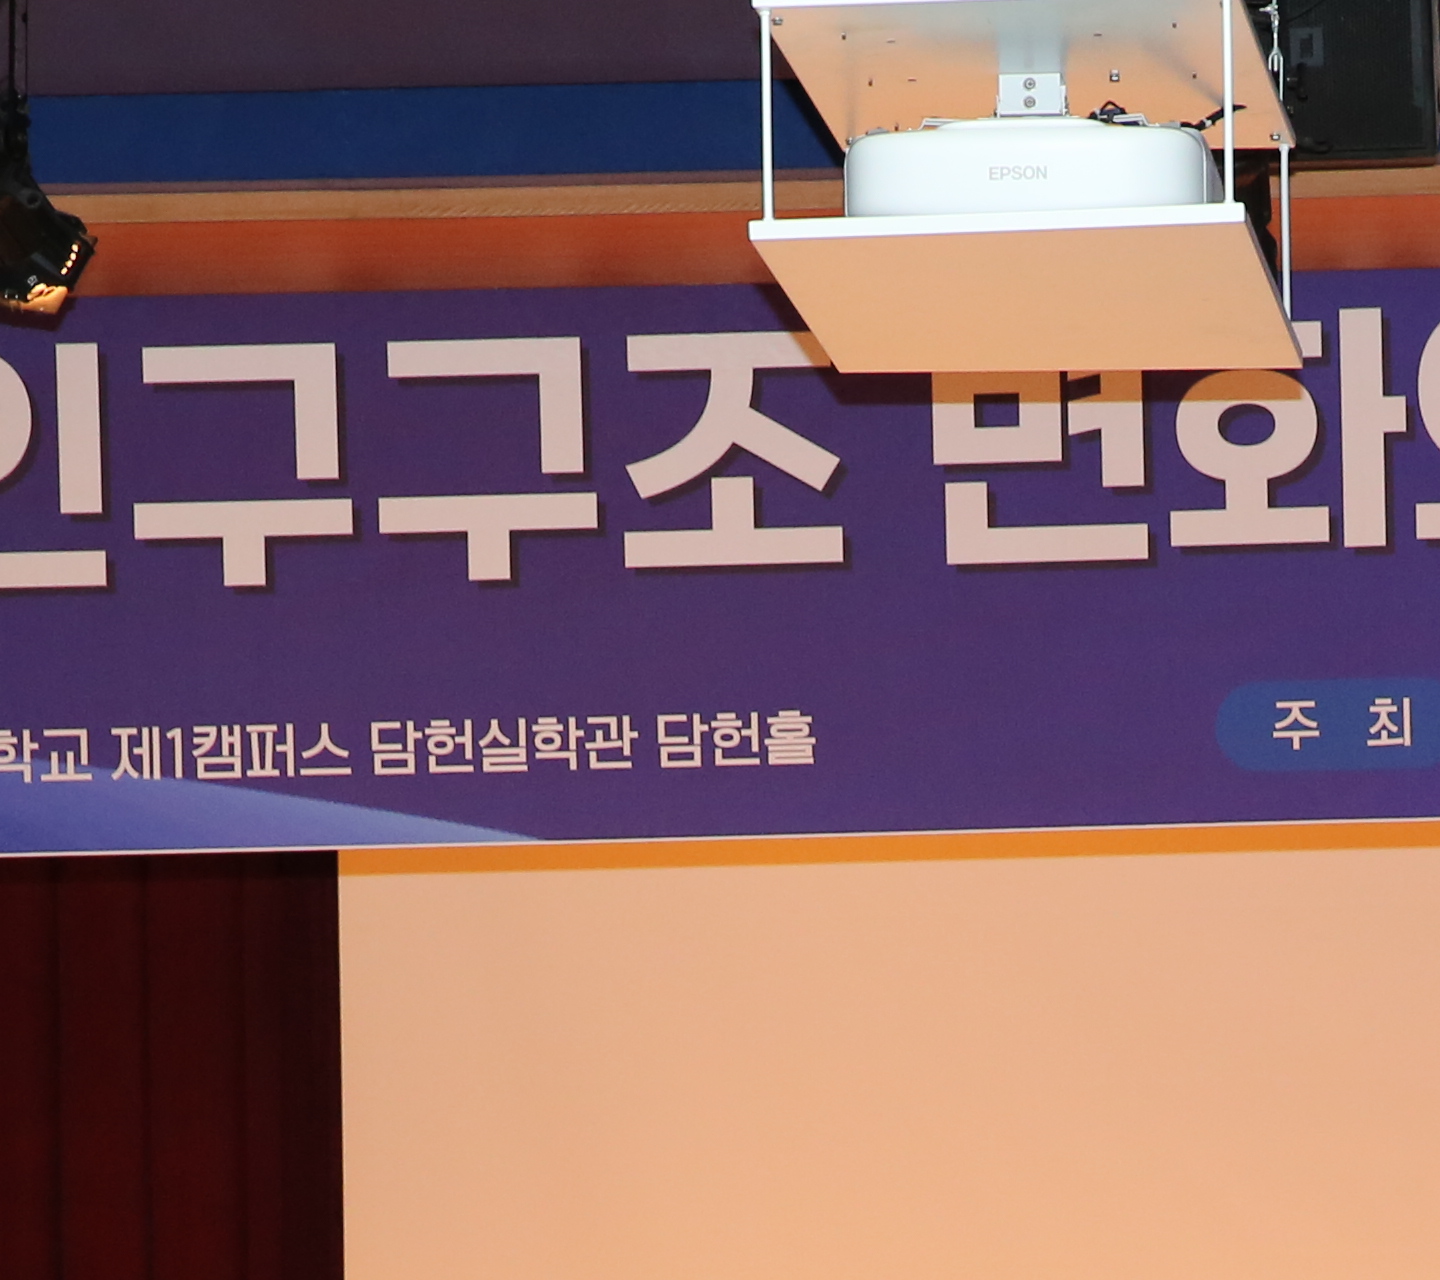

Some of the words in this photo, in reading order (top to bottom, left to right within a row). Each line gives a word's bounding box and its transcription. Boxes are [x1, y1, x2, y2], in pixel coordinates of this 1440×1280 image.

[988, 165, 1049, 181] EPSON
[110, 722, 353, 781] 제1캠퍼스
[370, 715, 639, 776] 담헌실학관
[657, 710, 817, 769] 담헌홀
